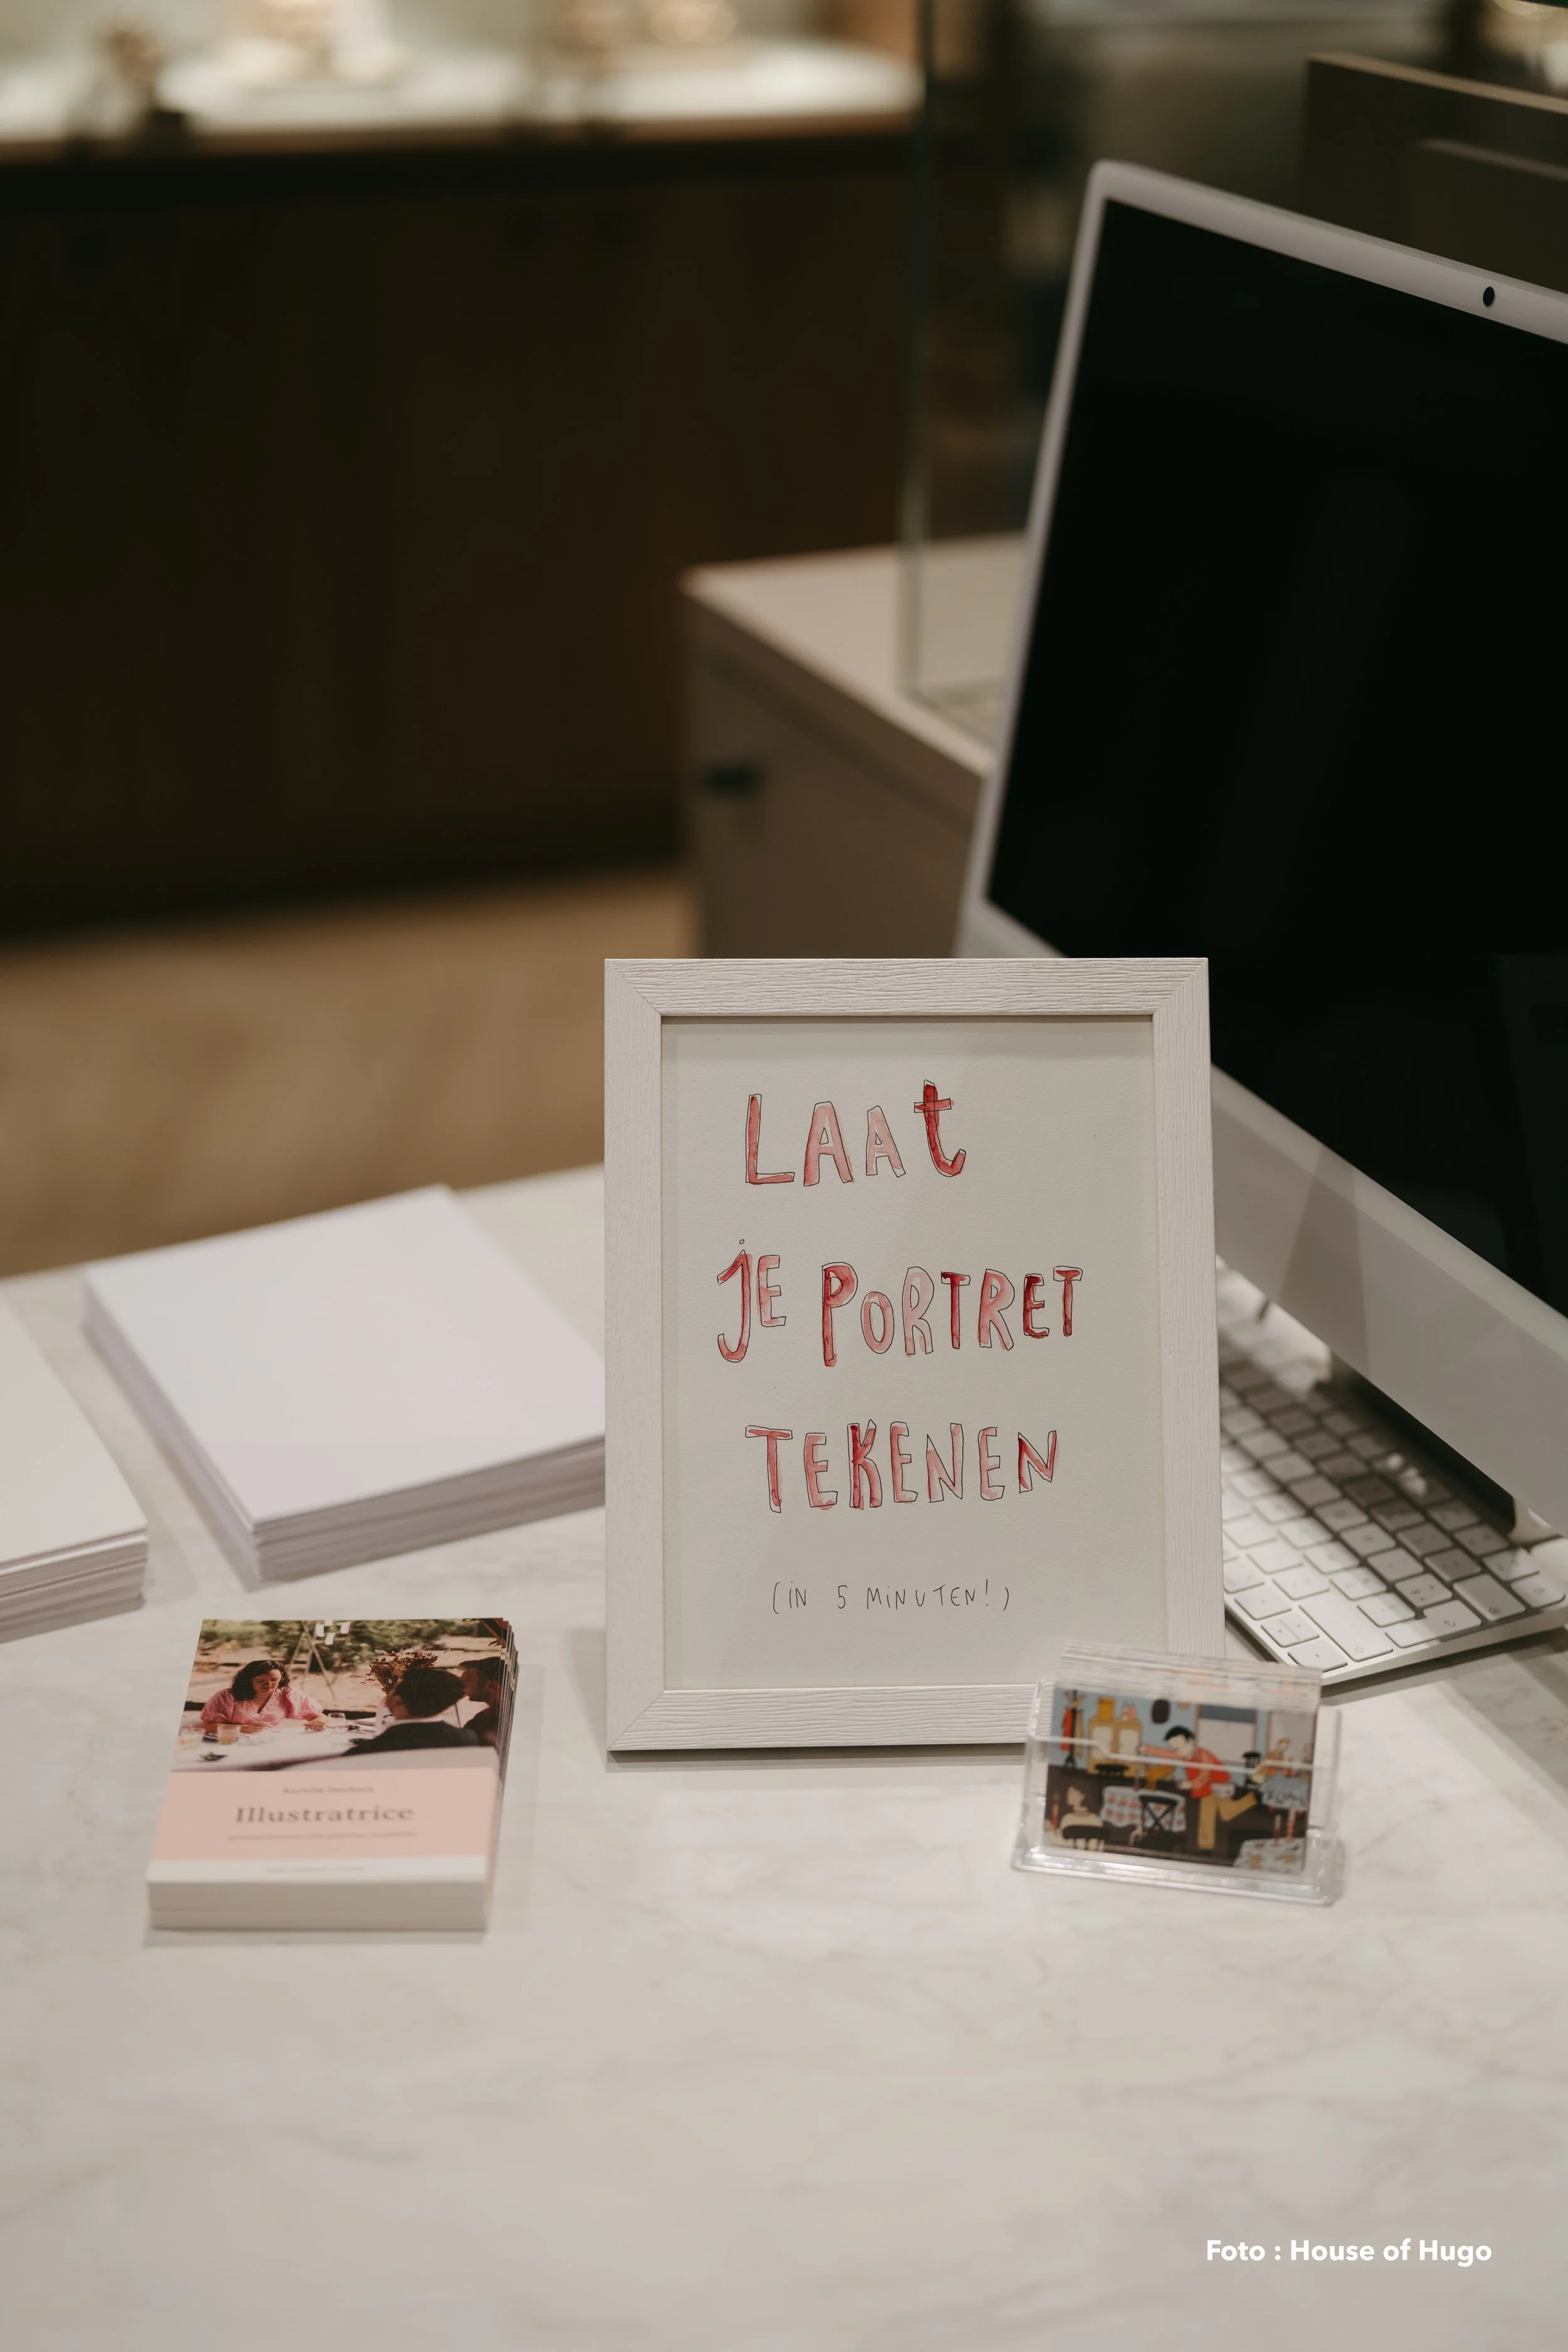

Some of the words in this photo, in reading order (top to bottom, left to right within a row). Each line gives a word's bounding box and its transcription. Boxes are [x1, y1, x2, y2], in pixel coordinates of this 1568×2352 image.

[821, 1261, 1083, 1367] PORTRET
[744, 1419, 1058, 1513] TEKENEN
[837, 1584, 848, 1609] 5
[234, 1804, 414, 1823] Illustratrice
